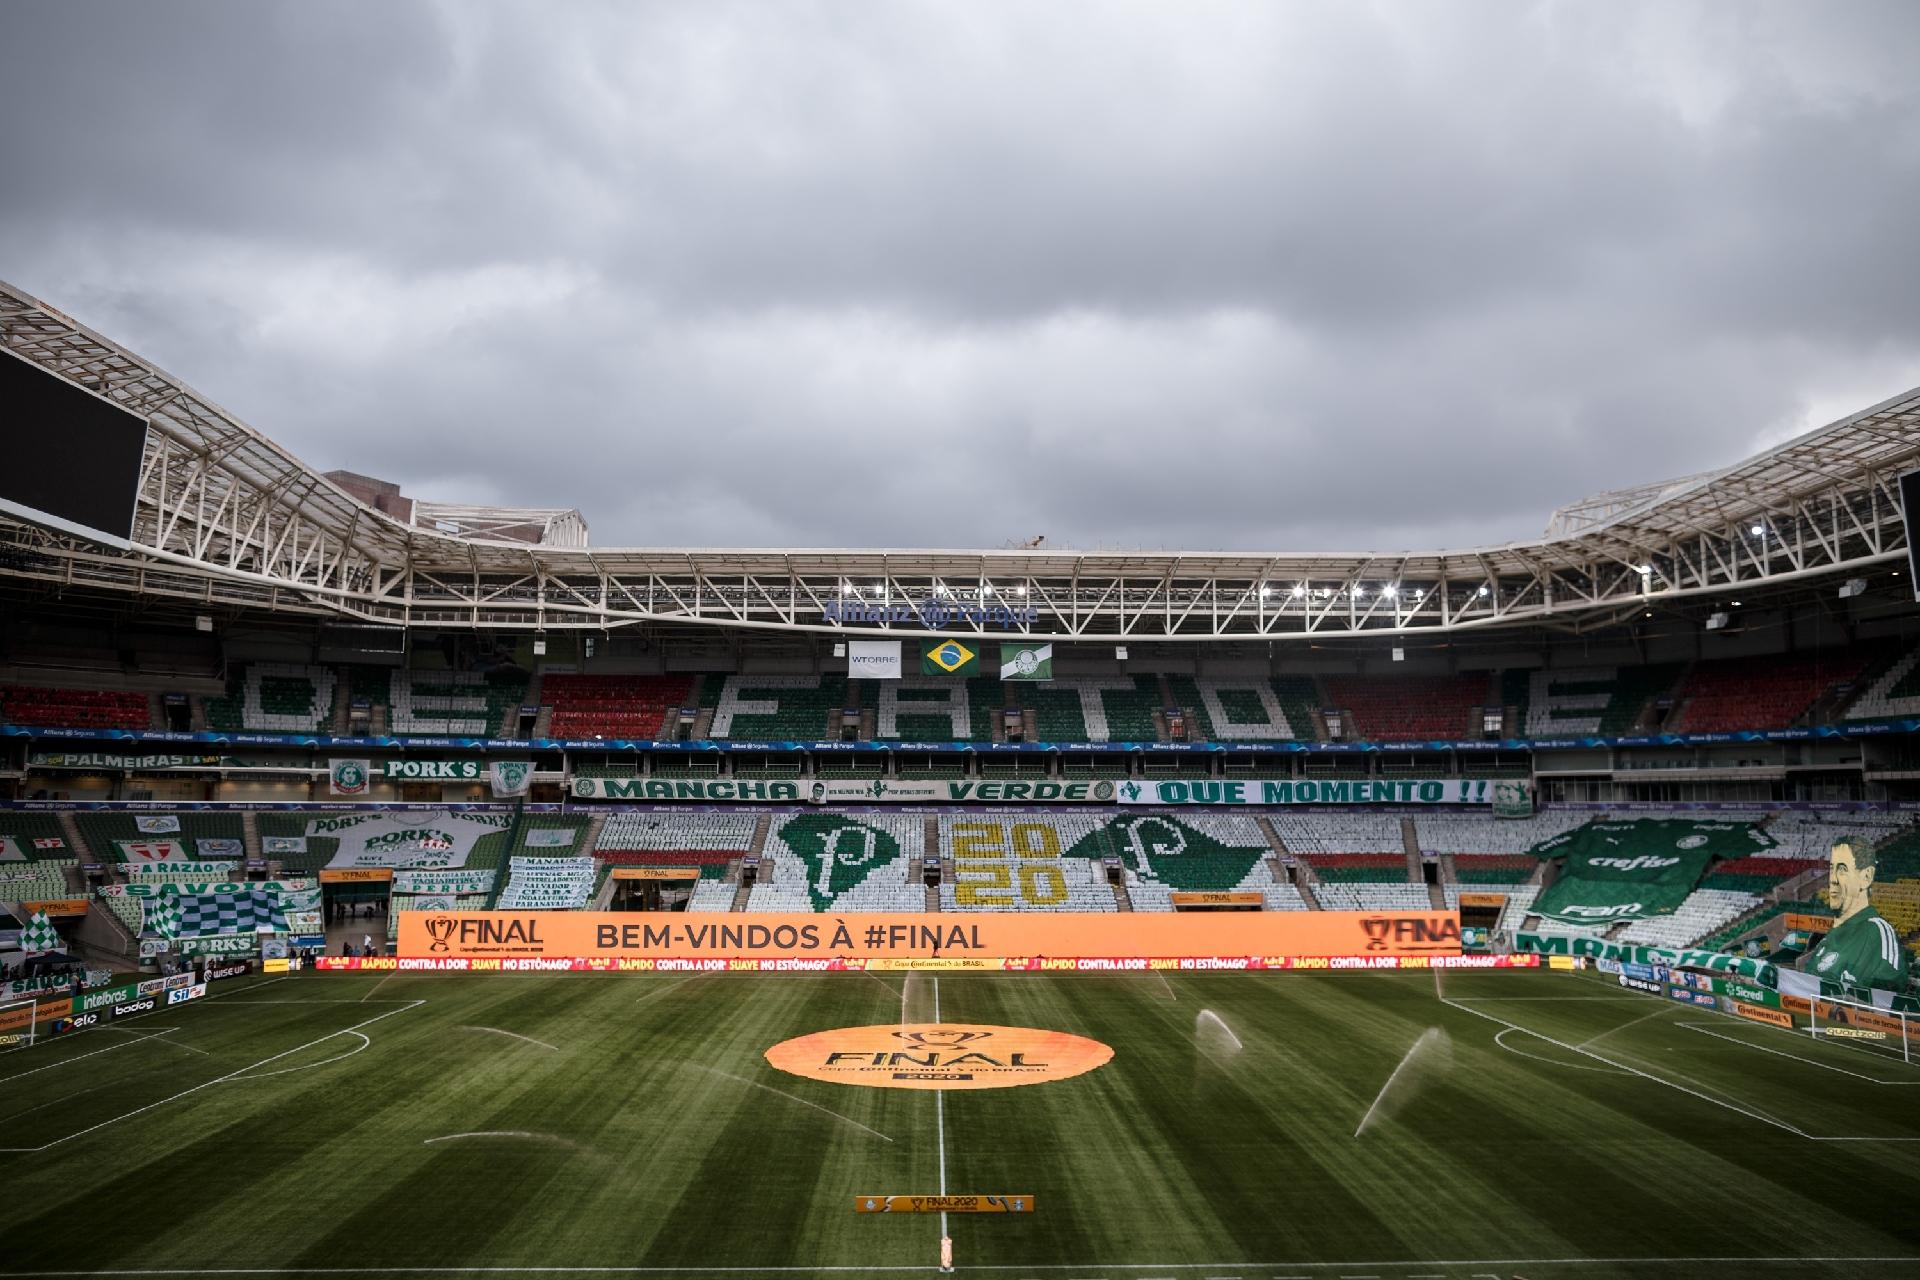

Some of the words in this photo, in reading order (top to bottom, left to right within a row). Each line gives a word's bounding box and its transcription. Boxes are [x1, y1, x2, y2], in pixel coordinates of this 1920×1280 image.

[823, 600, 911, 622] Allianz
[957, 604, 1038, 629] Parque
[64, 753, 183, 768] PALMEIRAS
[388, 761, 477, 777] PORK'S
[604, 780, 799, 800] MANCHA
[949, 781, 1090, 800] VERDE
[1158, 782, 1247, 804] QUE
[1262, 781, 1444, 803] MOMENTO
[143, 864, 152, 872] A
[125, 882, 284, 896] SAVOIA
[413, 884, 479, 892] PERUS
[460, 920, 544, 944] FINAL
[597, 924, 820, 948] BEM-VINDOS
[830, 918, 854, 948] À
[864, 925, 987, 948] #FINAL
[361, 956, 396, 970] RÁPIDO
[398, 959, 438, 970] CONTRA
[438, 959, 445, 970] A
[471, 959, 500, 970] SUAVE
[502, 959, 517, 970] NO
[619, 957, 654, 970] RÁPIDO
[656, 960, 695, 970] CONTRA
[696, 960, 704, 970] A
[730, 960, 758, 970] SUAVE
[760, 960, 775, 970] NO
[1040, 956, 1076, 970] RÁPIDO
[1078, 959, 1116, 970] CONTRA
[1116, 959, 1124, 970] A
[1150, 959, 1178, 970] SUAVE
[1180, 959, 1194, 970] NO
[1294, 956, 1328, 968] RÁPIDO
[1330, 958, 1368, 968] CONTRA
[1368, 958, 1376, 968] A
[1400, 958, 1430, 968] SUAVE
[1430, 958, 1444, 968] NO
[214, 968, 232, 979] WISE
[232, 965, 246, 976] UP
[1658, 968, 1670, 984] Sil
[1684, 973, 1698, 989] Sil
[84, 990, 126, 1009] intelbras
[173, 990, 189, 1002] Sil
[1736, 986, 1764, 1002] Sicredi
[115, 1000, 154, 1016] bodog
[74, 1014, 98, 1028] elo
[825, 1052, 1048, 1068] FINAL
[927, 1198, 953, 1206] FINAL
[955, 1198, 978, 1206] 2020
